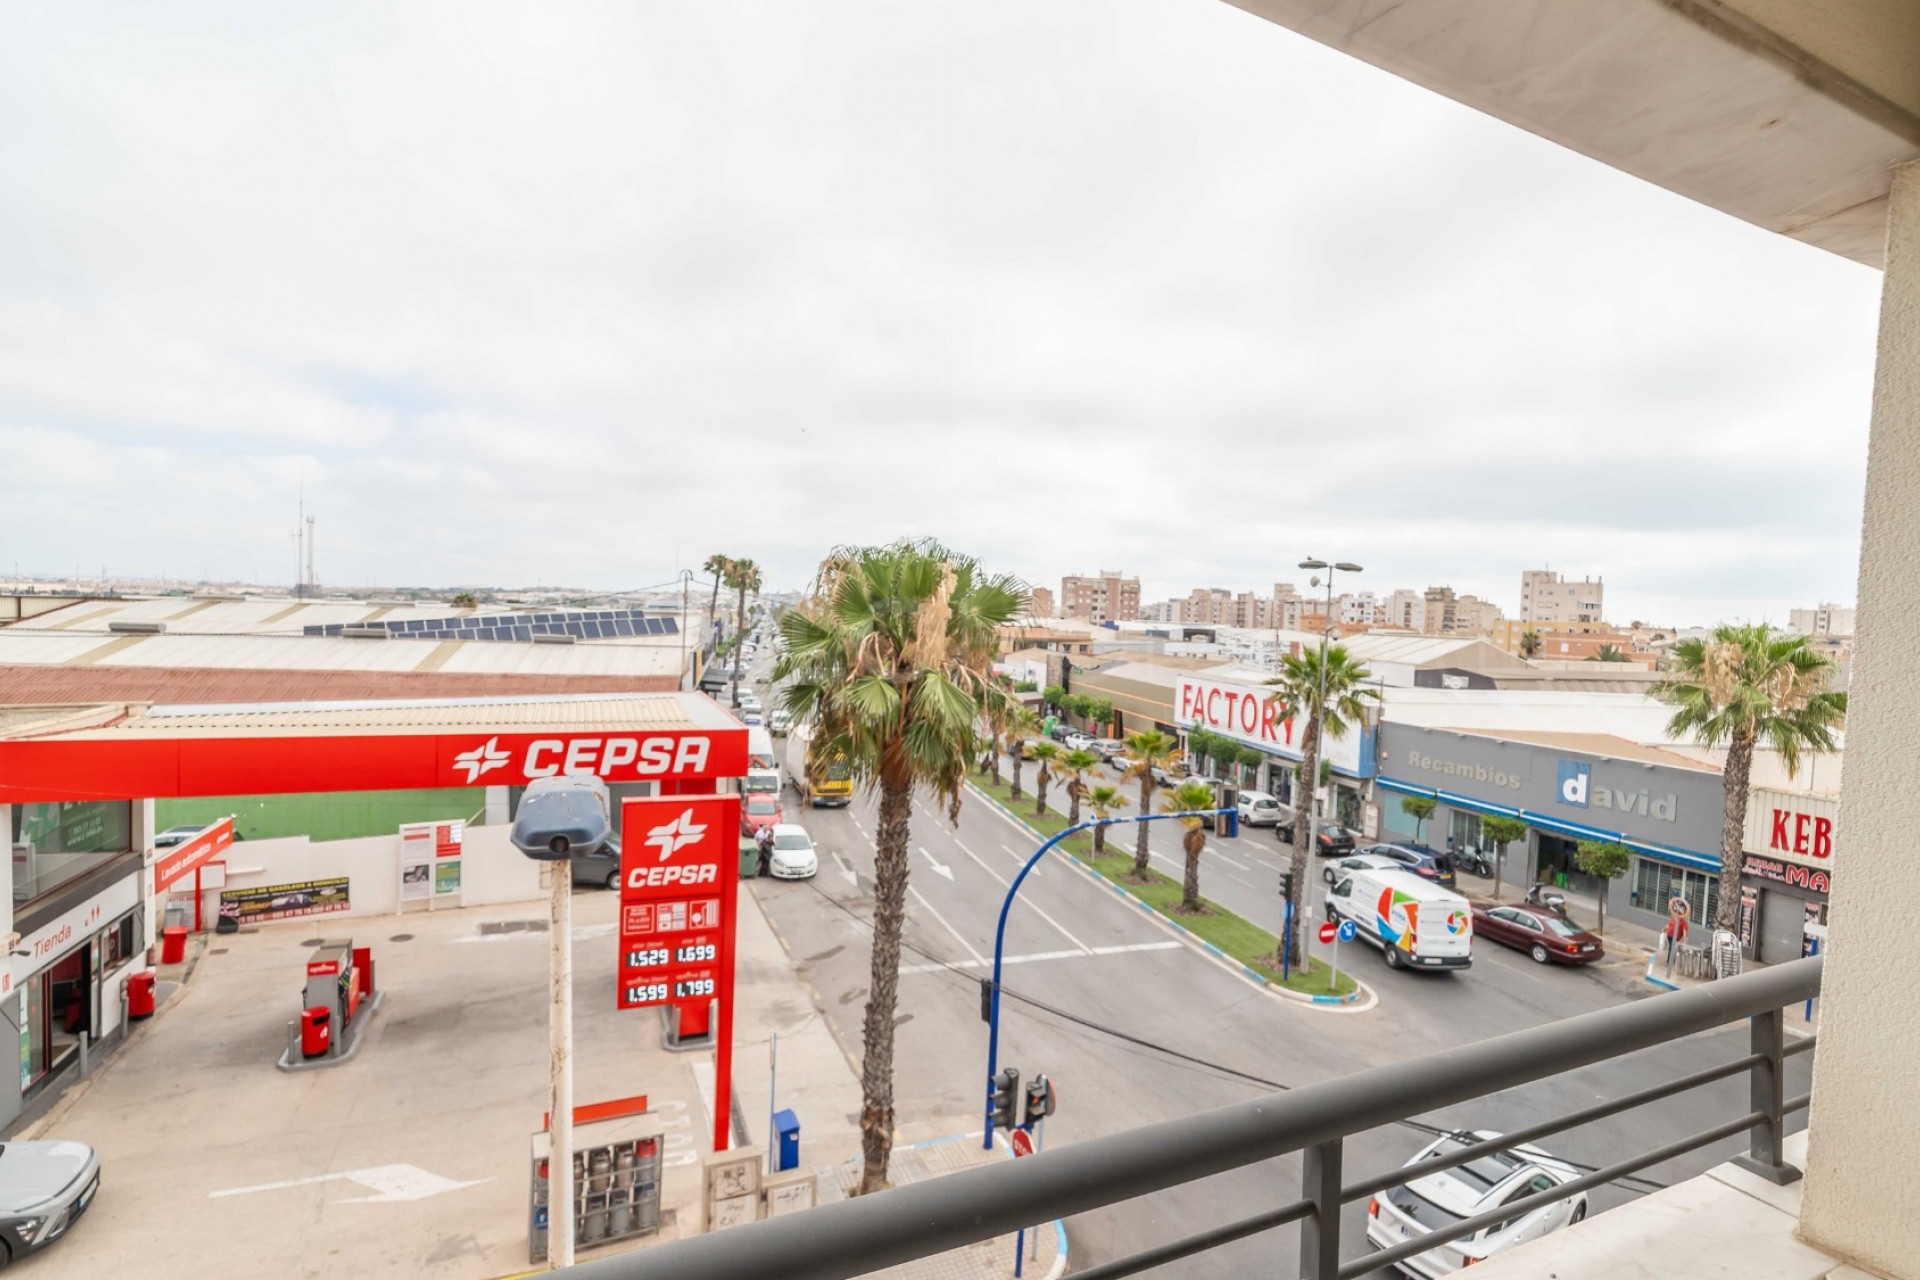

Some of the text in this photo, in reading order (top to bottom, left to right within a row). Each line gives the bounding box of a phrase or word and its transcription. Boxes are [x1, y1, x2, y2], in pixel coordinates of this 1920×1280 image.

[1182, 684, 1294, 745] FACTORY
[523, 736, 711, 777] CEPSA
[1408, 750, 1522, 790] Recambios
[1563, 774, 1677, 822] david
[1770, 809, 1831, 859] KEB
[627, 864, 718, 889] CEPSA
[34, 924, 72, 959] Tienda
[630, 949, 669, 967] 1.529
[678, 945, 715, 962] 1.699
[628, 984, 668, 1003] 1.599
[676, 980, 714, 997] 1.799
